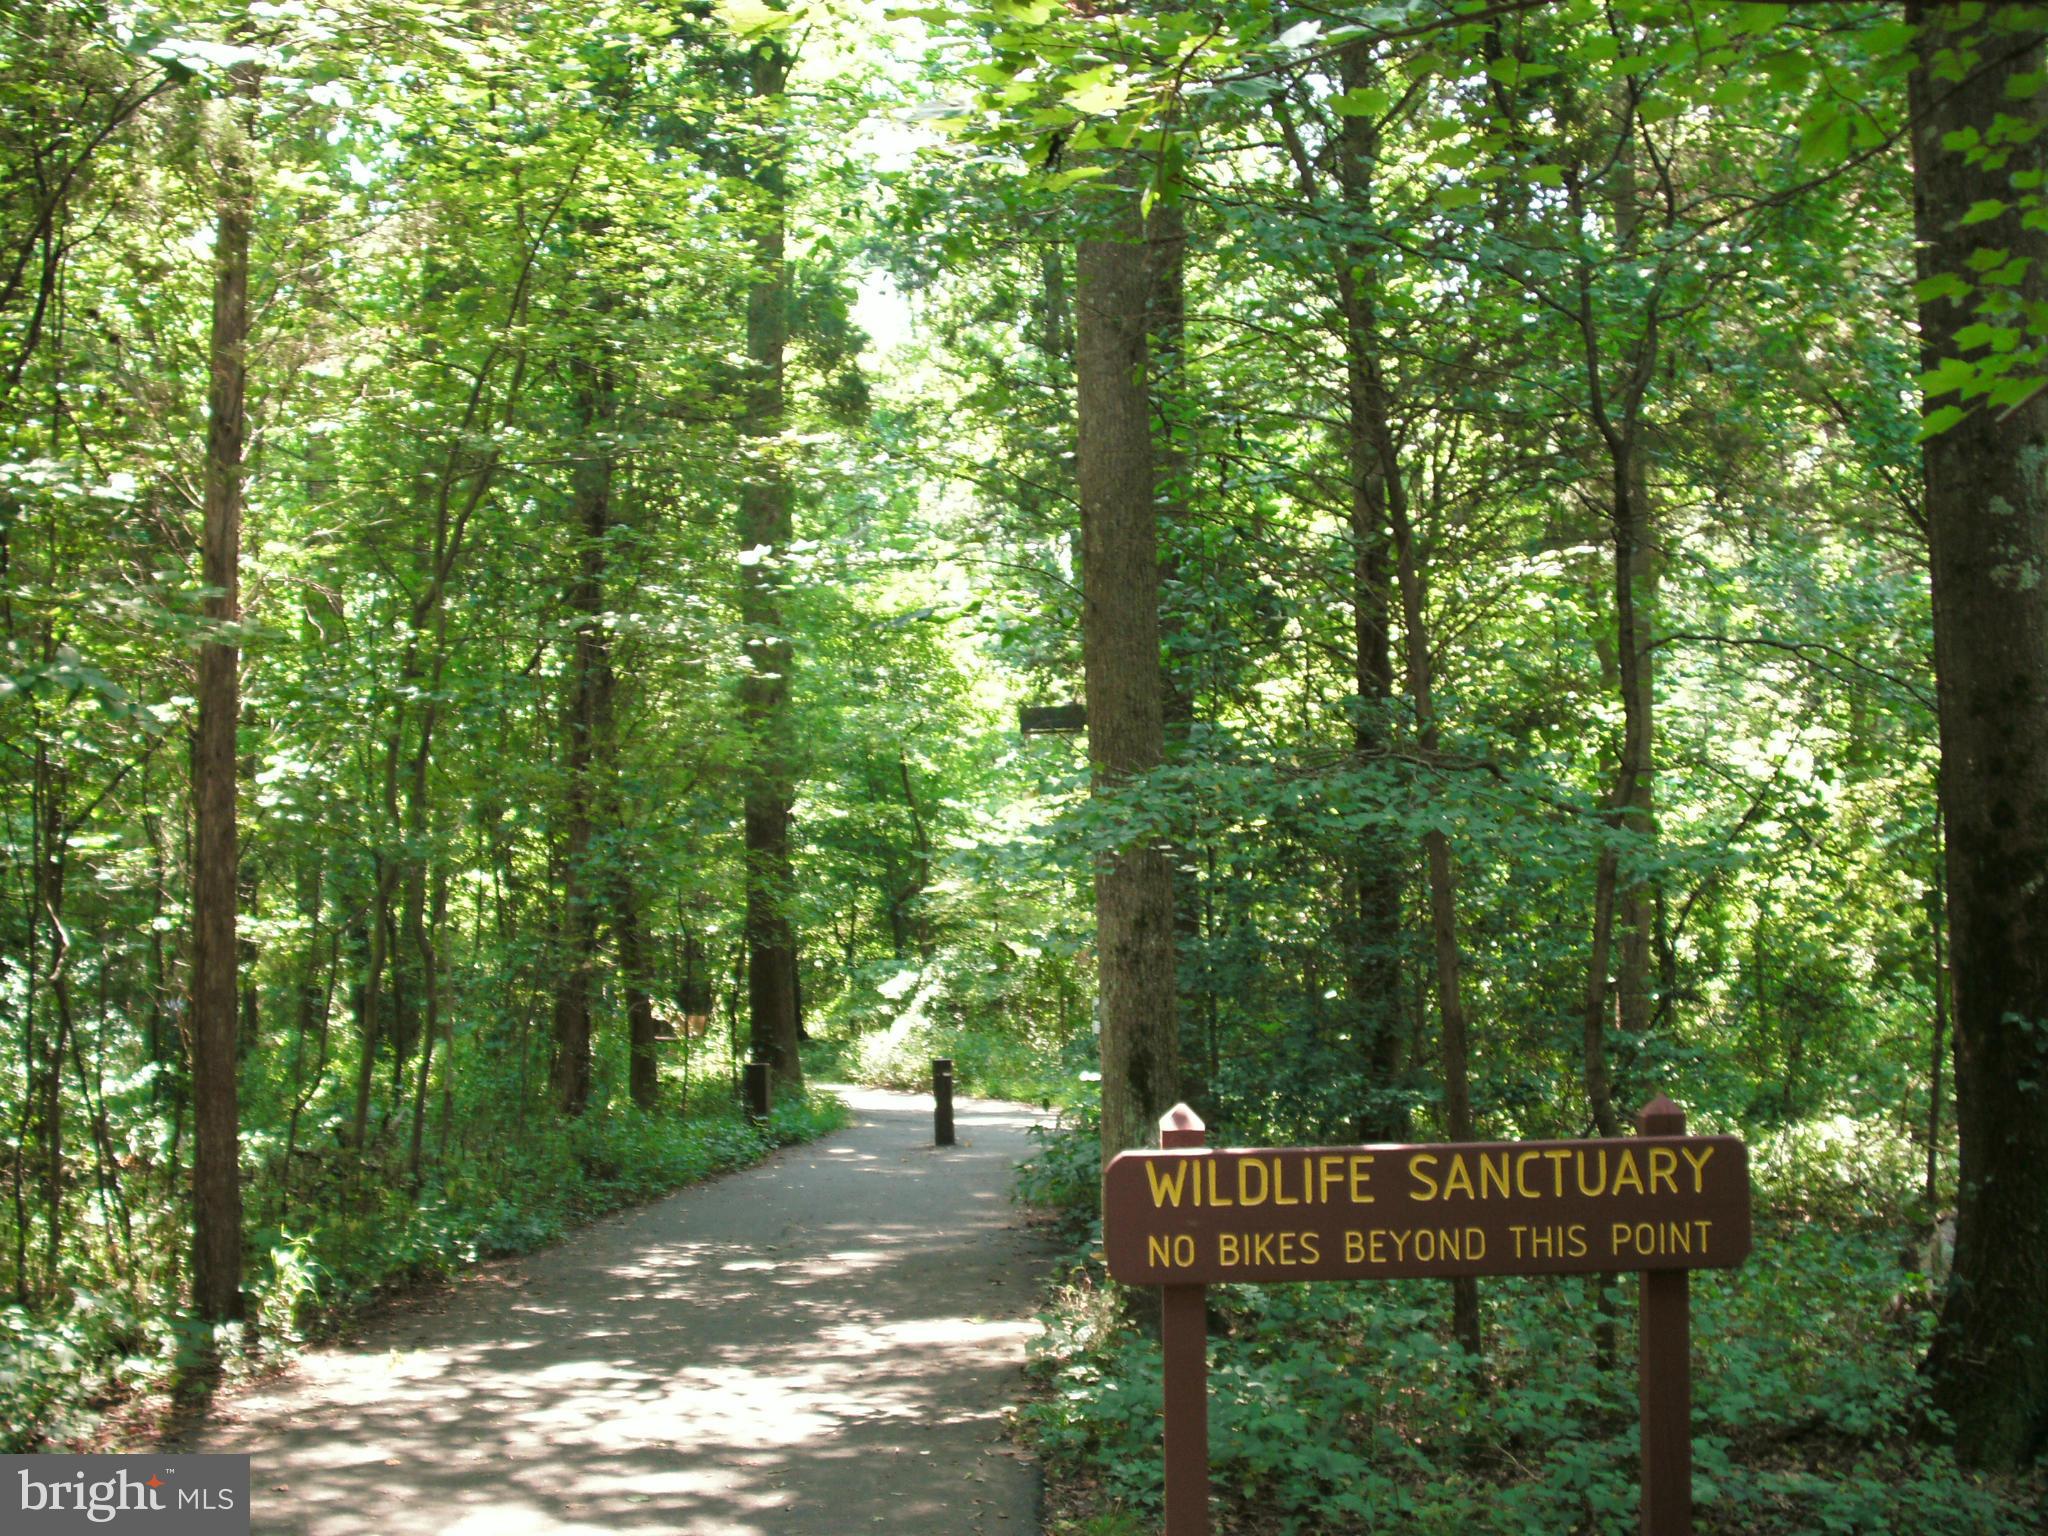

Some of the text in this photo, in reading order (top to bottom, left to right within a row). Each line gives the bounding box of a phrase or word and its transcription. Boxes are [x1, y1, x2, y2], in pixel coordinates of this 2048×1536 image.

[1145, 1146, 1715, 1208] WILDLIFE SANCTUARY
[1147, 1220, 1713, 1269] NO BIKES BEYOND THIS POINT
